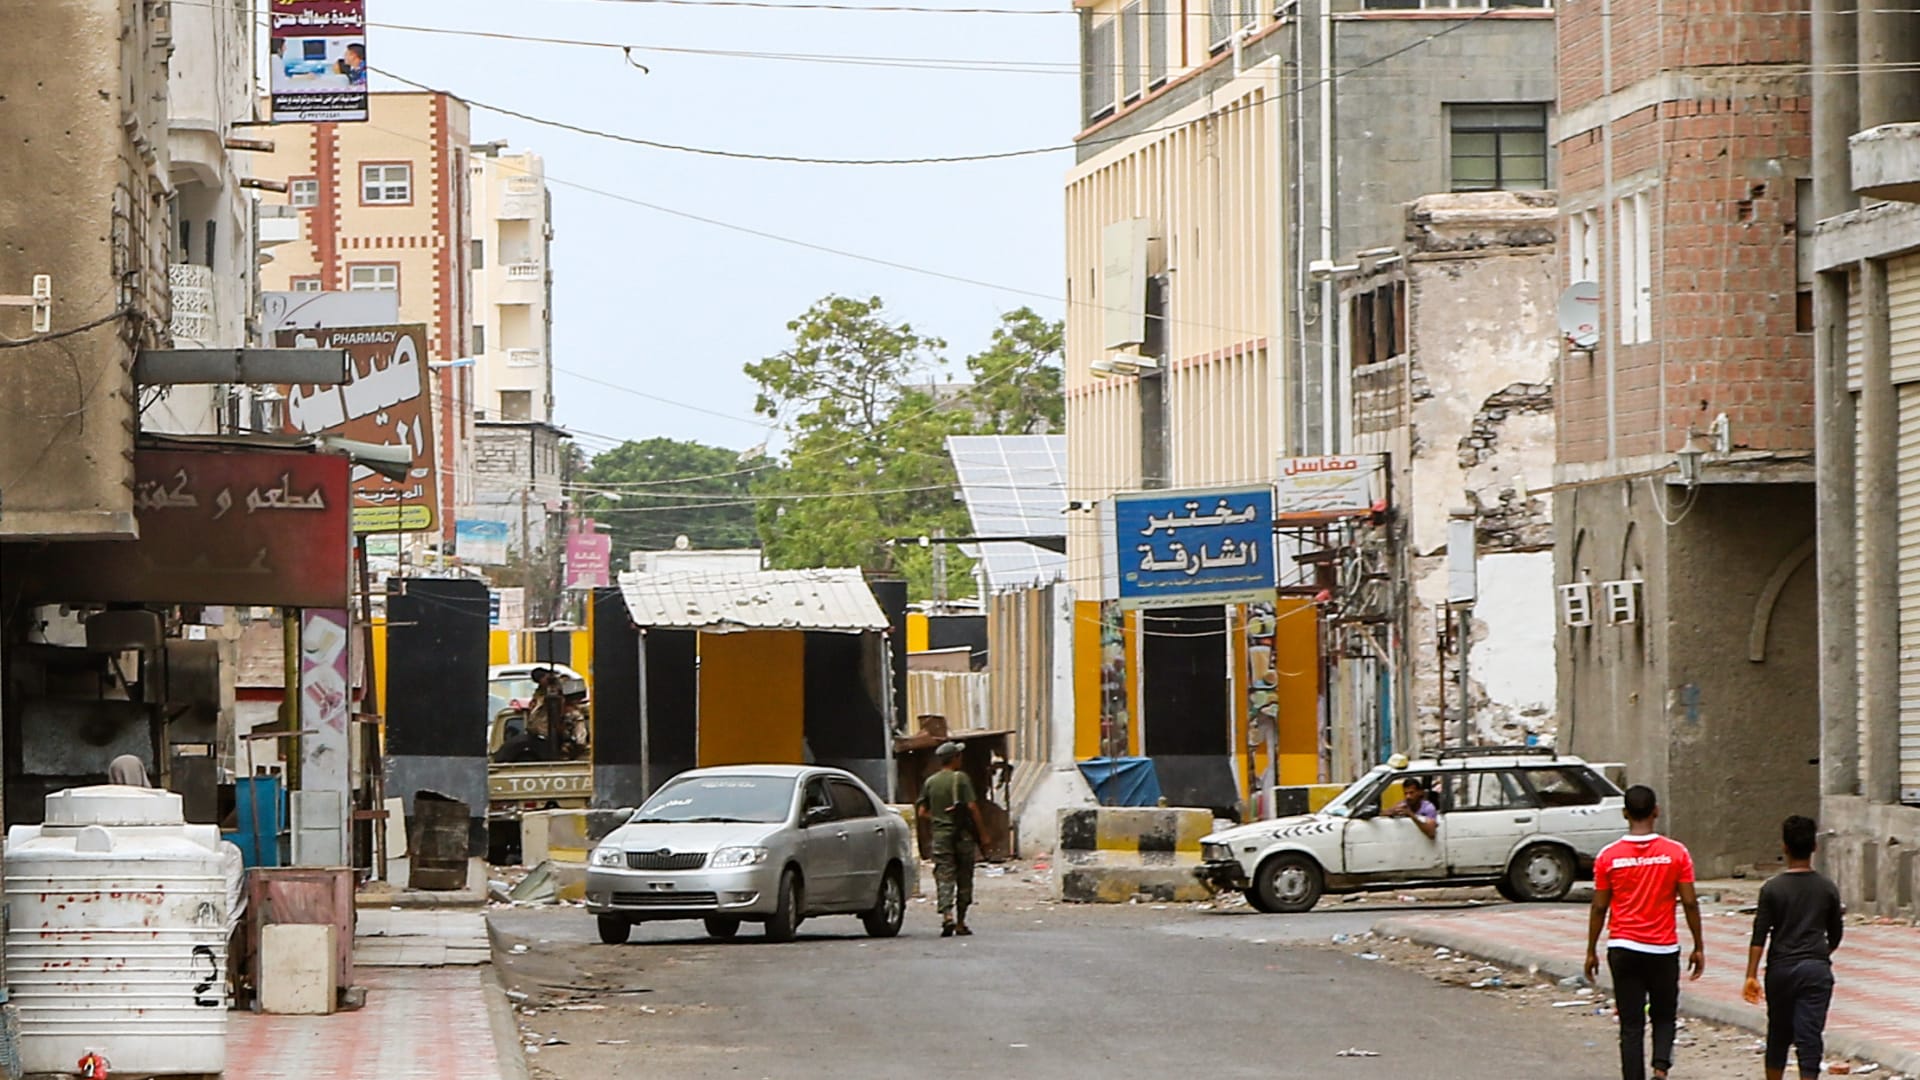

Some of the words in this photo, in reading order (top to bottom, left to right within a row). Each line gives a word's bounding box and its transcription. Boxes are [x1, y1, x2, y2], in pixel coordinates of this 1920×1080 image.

[332, 331, 397, 345] PHARMACY
[1284, 456, 1357, 476] مغاسل
[213, 488, 232, 520] و
[246, 473, 326, 514] مطعم
[1140, 499, 1256, 536] مختبر
[1137, 538, 1257, 576] الشارقة
[508, 777, 592, 792] TOYOTA
